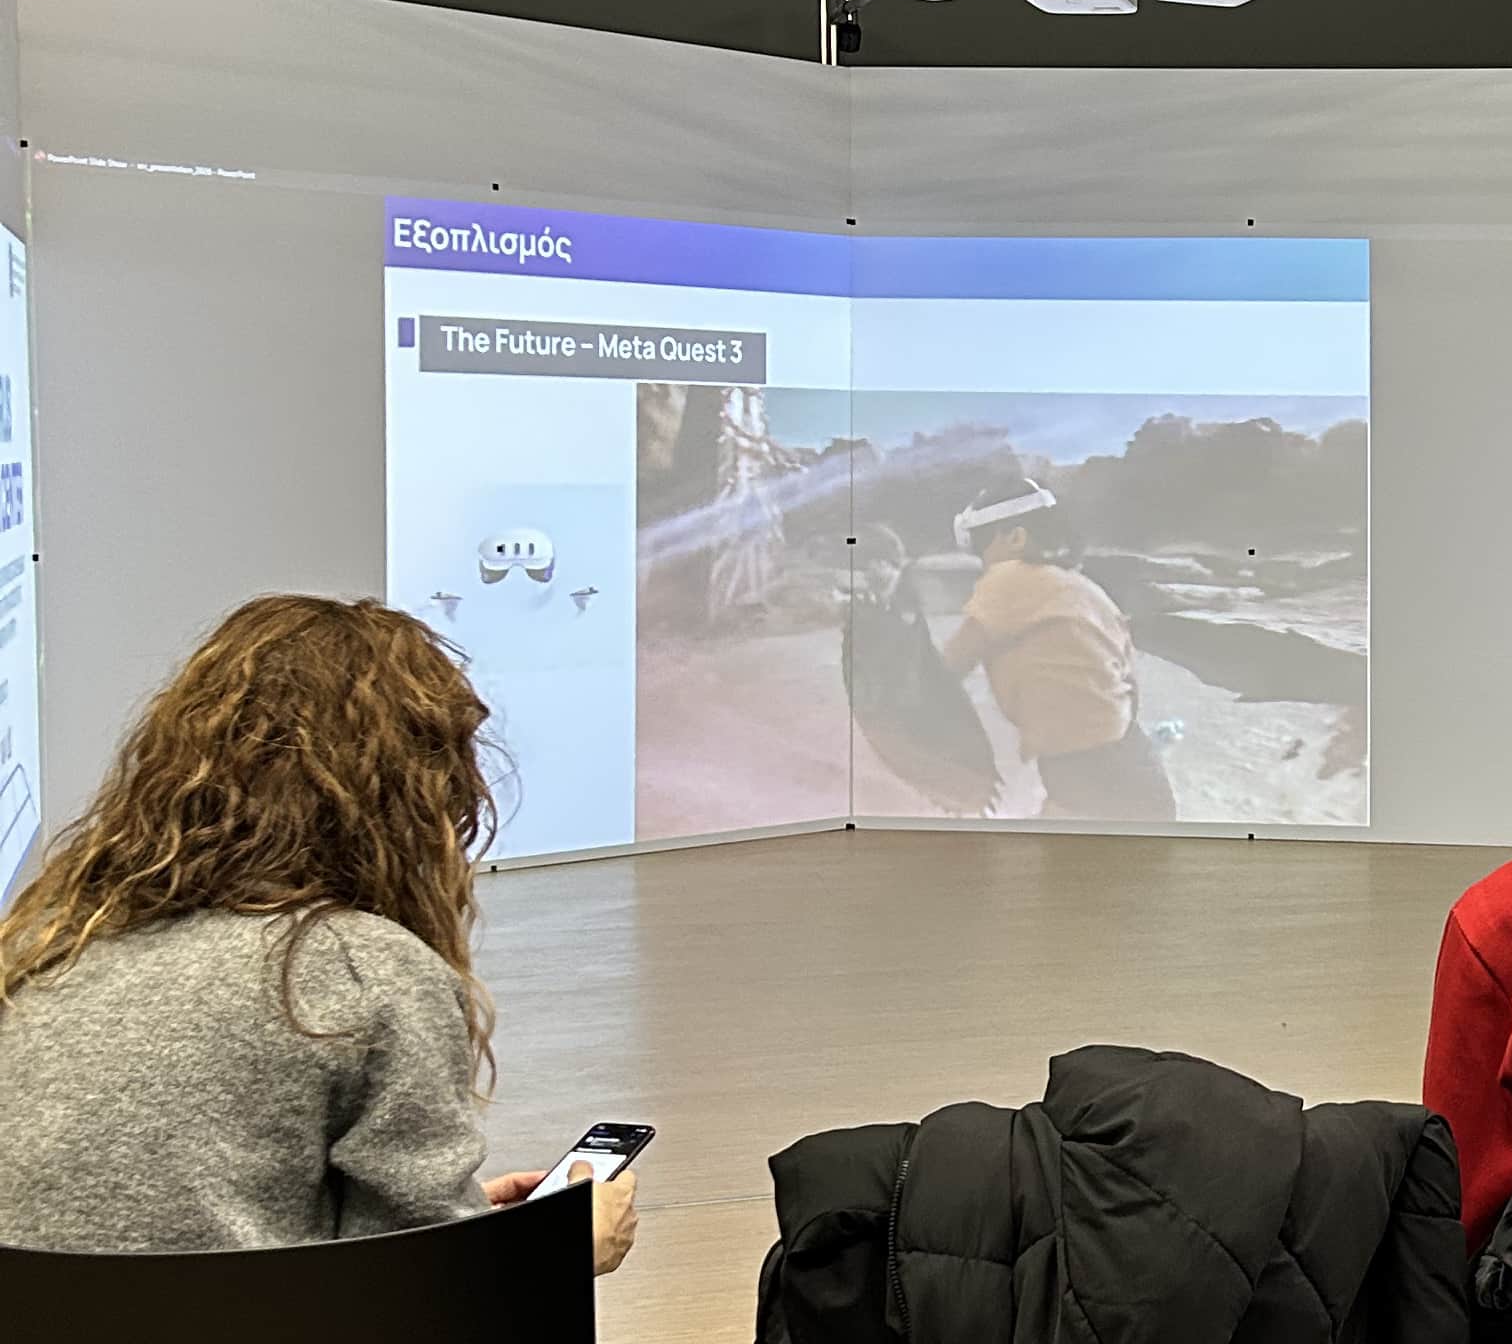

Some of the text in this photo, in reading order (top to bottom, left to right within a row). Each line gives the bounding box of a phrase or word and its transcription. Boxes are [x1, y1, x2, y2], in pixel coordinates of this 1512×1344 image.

[393, 218, 572, 264] Εξοπλισμός
[440, 326, 490, 353] The
[496, 329, 576, 356] Future
[599, 333, 656, 360] Meta
[660, 336, 727, 364] Quest
[729, 340, 743, 364] 3
